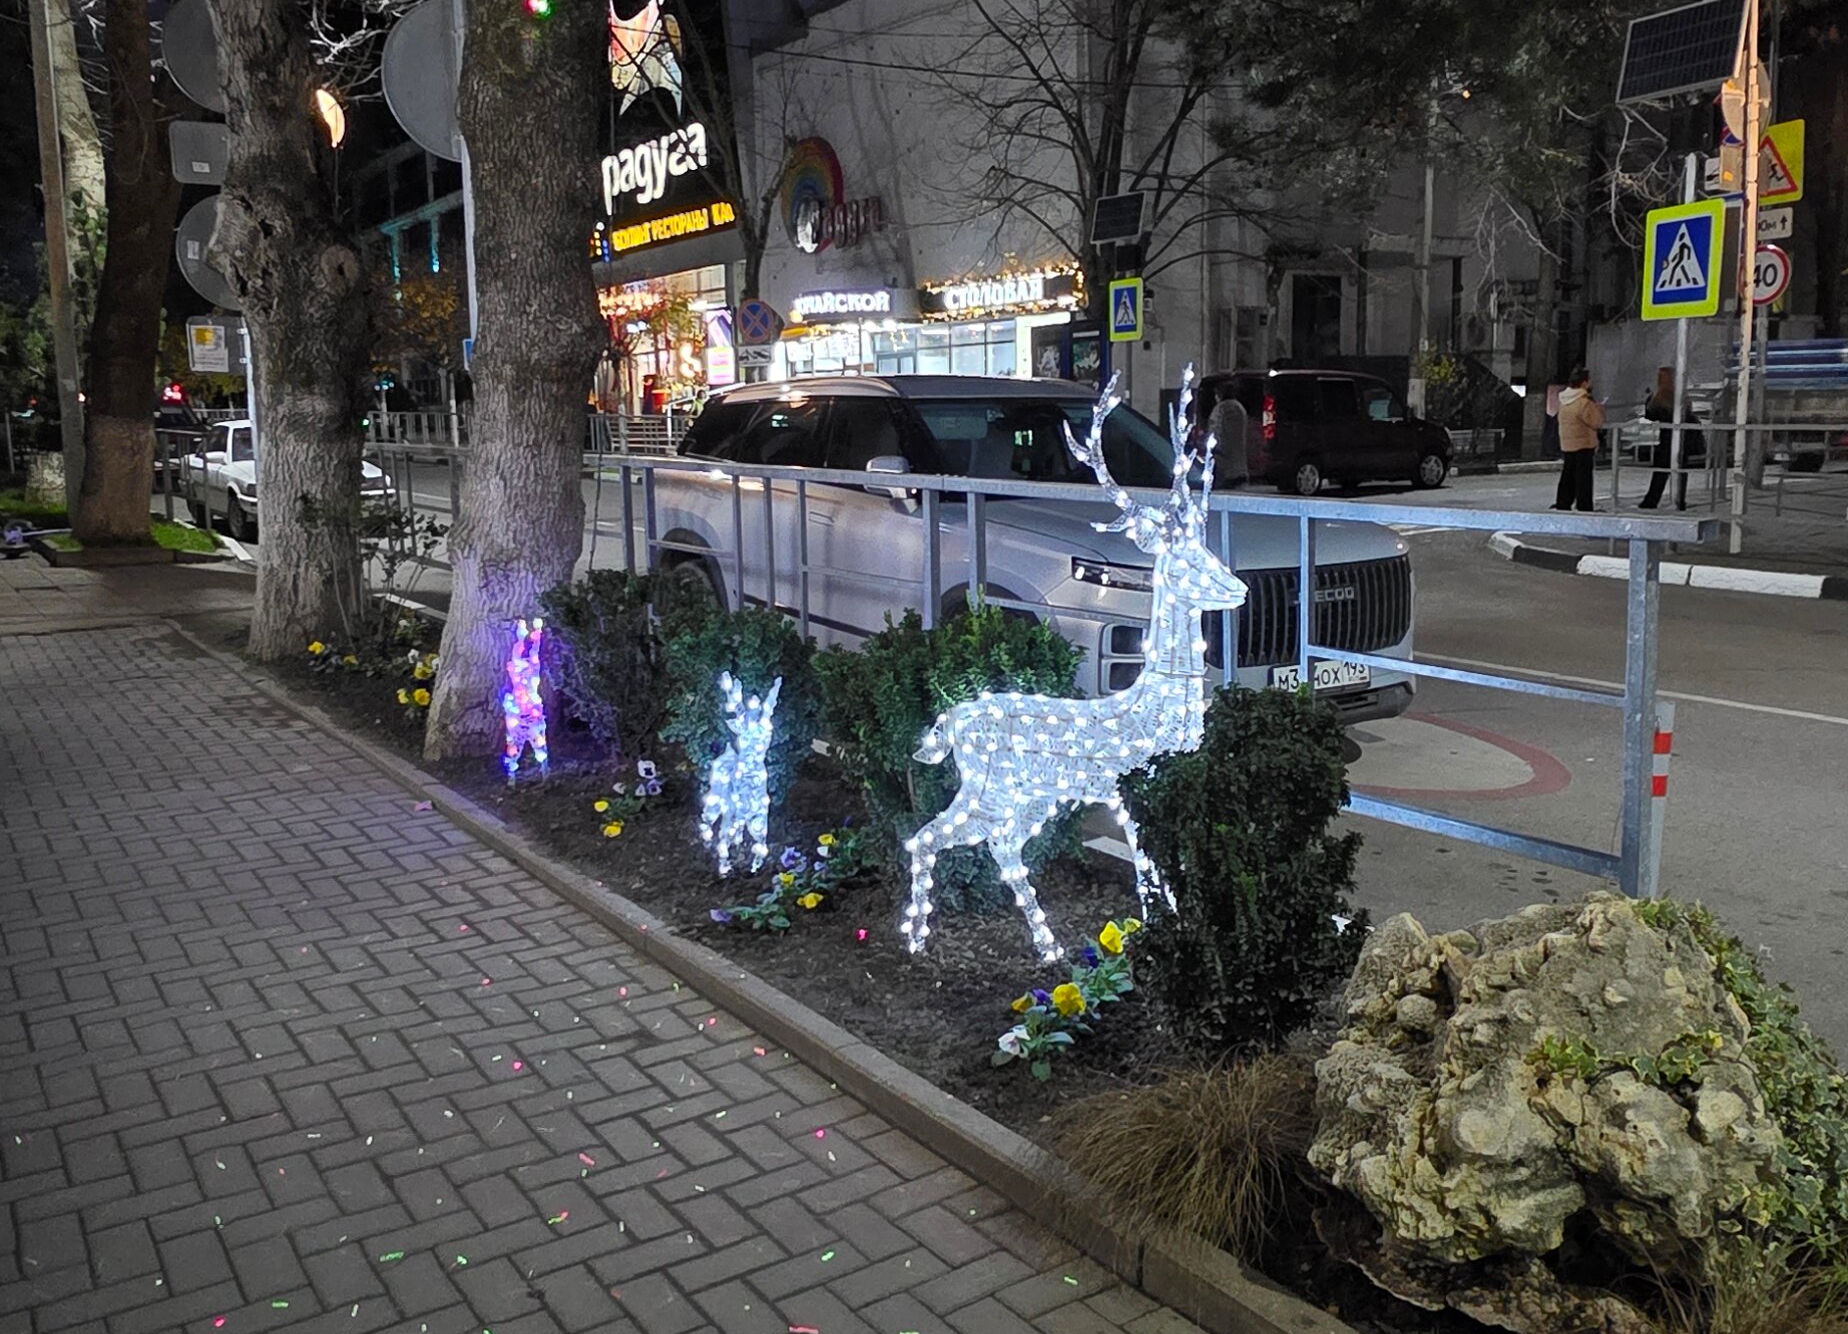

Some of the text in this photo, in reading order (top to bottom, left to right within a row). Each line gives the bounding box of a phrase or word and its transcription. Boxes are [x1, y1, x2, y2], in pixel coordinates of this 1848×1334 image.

[651, 207, 709, 240] РЕСТОРАНЫ
[1753, 263, 1777, 288] 40
[944, 278, 1043, 310] СТОЛОВАЯ
